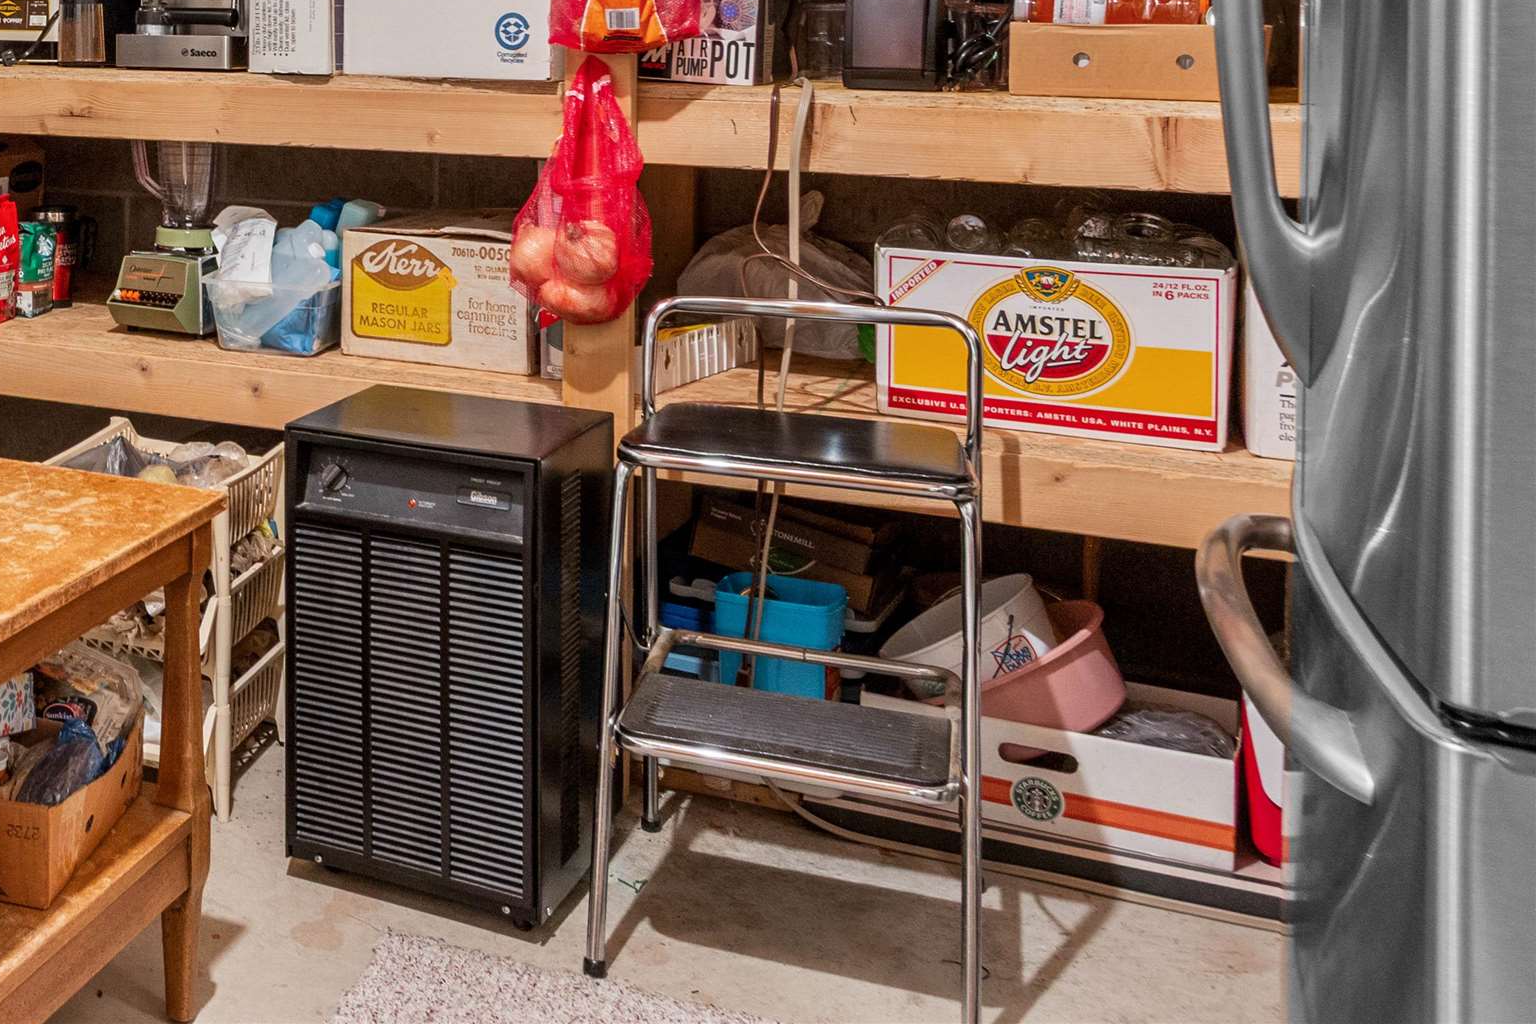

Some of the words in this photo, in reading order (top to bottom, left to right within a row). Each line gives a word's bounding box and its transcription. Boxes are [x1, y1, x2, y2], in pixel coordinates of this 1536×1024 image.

[190, 48, 217, 59] Saeco
[677, 41, 708, 58] AIR
[676, 57, 708, 77] PUMP
[711, 40, 755, 80] POT
[363, 242, 440, 278] Kerr
[891, 261, 938, 301] IMPORTED
[1153, 282, 1178, 291] 24/12
[468, 297, 483, 309] for
[485, 299, 517, 314] home
[1164, 290, 1174, 301] 6
[1177, 292, 1210, 301] PACKS
[372, 302, 429, 318] REGULAR
[457, 309, 505, 326] canning
[508, 314, 517, 326] &
[359, 315, 407, 331] MASON
[411, 321, 441, 335] JARS
[468, 321, 517, 341] freezing
[993, 310, 1103, 340] AMSTEL
[1001, 329, 1093, 384] light
[893, 395, 946, 408] EXCLUSIVE
[983, 406, 1033, 418] PORTERS:
[1036, 411, 1078, 423] AMSTEL
[1111, 420, 1143, 430] WHITE
[1147, 423, 1190, 435] PLAINS,
[1194, 428, 1214, 437] N.Y.
[470, 490, 498, 505] Gibson
[1016, 778, 1059, 802] STARBUCKS
[1020, 804, 1052, 819] COFFEE
